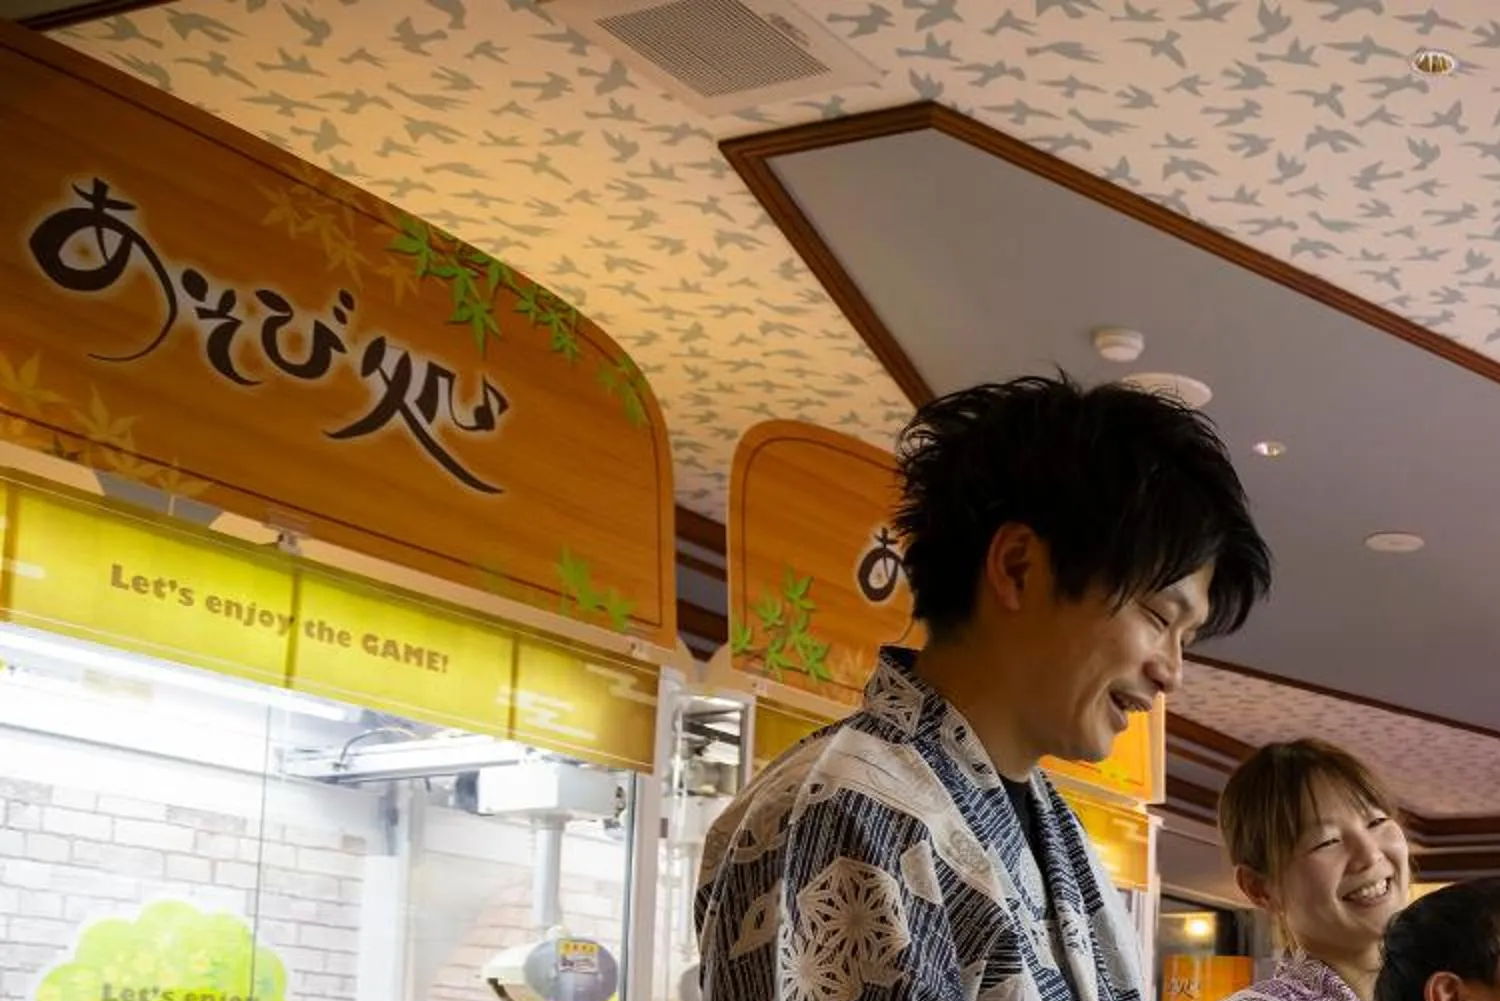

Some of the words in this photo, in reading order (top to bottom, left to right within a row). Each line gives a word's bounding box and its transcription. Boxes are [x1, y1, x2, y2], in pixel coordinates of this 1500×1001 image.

[29, 177, 509, 494] あそび処
[110, 564, 194, 607] Let's
[205, 595, 294, 636] enjoy
[304, 619, 351, 648] the
[361, 633, 449, 673] GAME!
